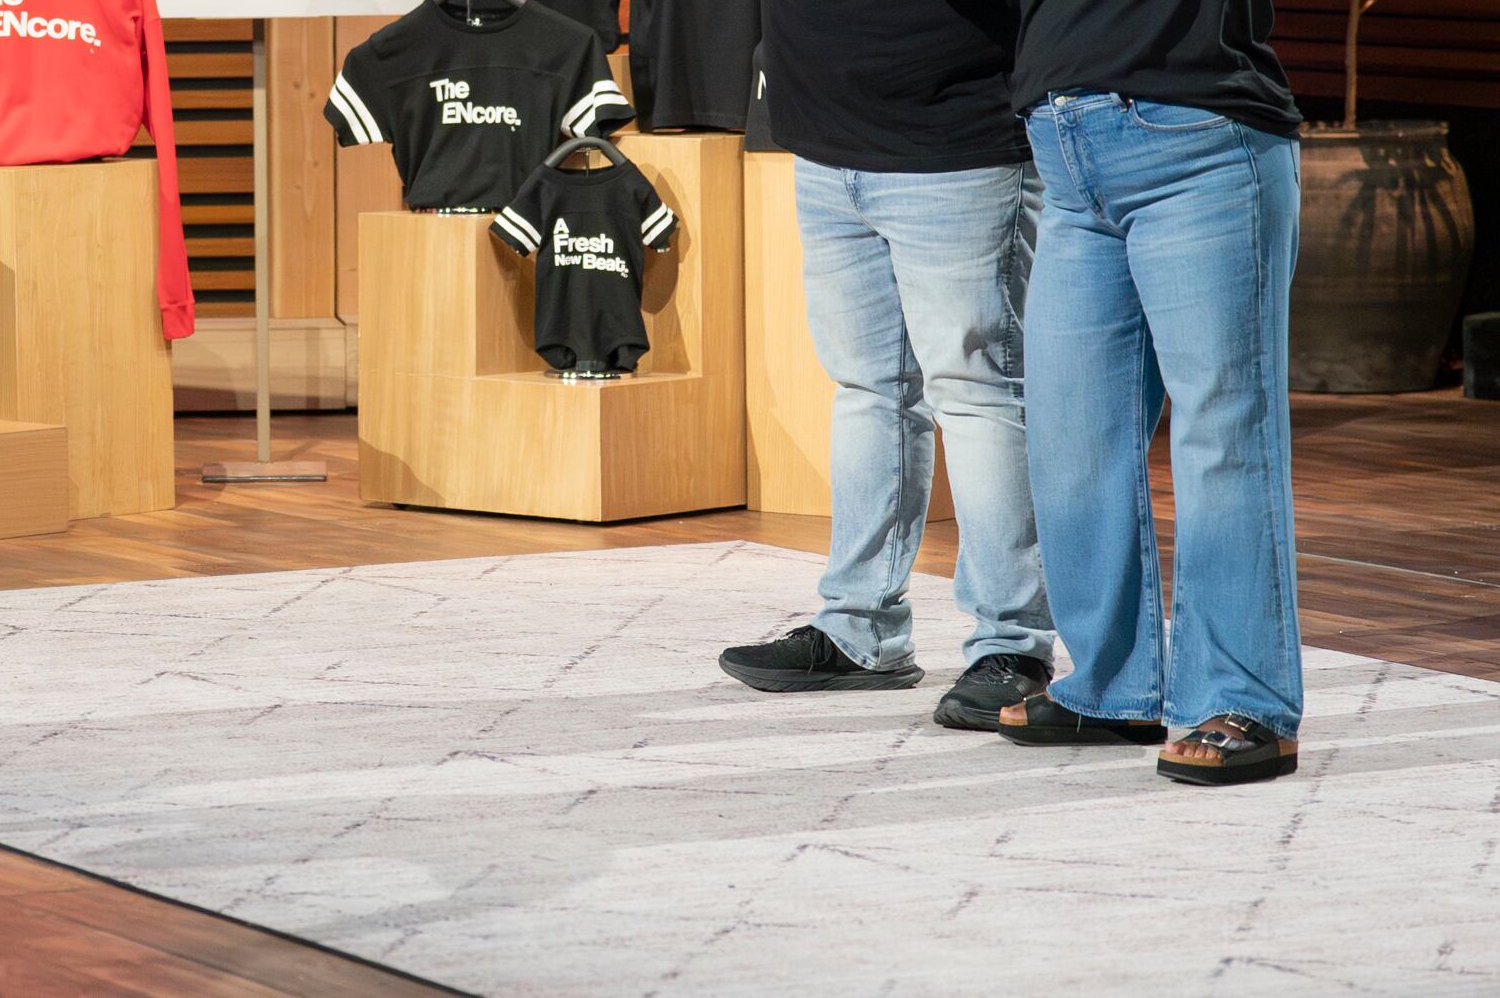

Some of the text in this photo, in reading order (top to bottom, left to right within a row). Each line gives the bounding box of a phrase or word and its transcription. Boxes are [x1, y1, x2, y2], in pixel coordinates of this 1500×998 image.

[429, 78, 471, 102] The
[442, 101, 522, 126] ENcore.
[553, 217, 570, 235] A
[553, 233, 615, 254] Fresh
[554, 253, 629, 273] New Beat.
